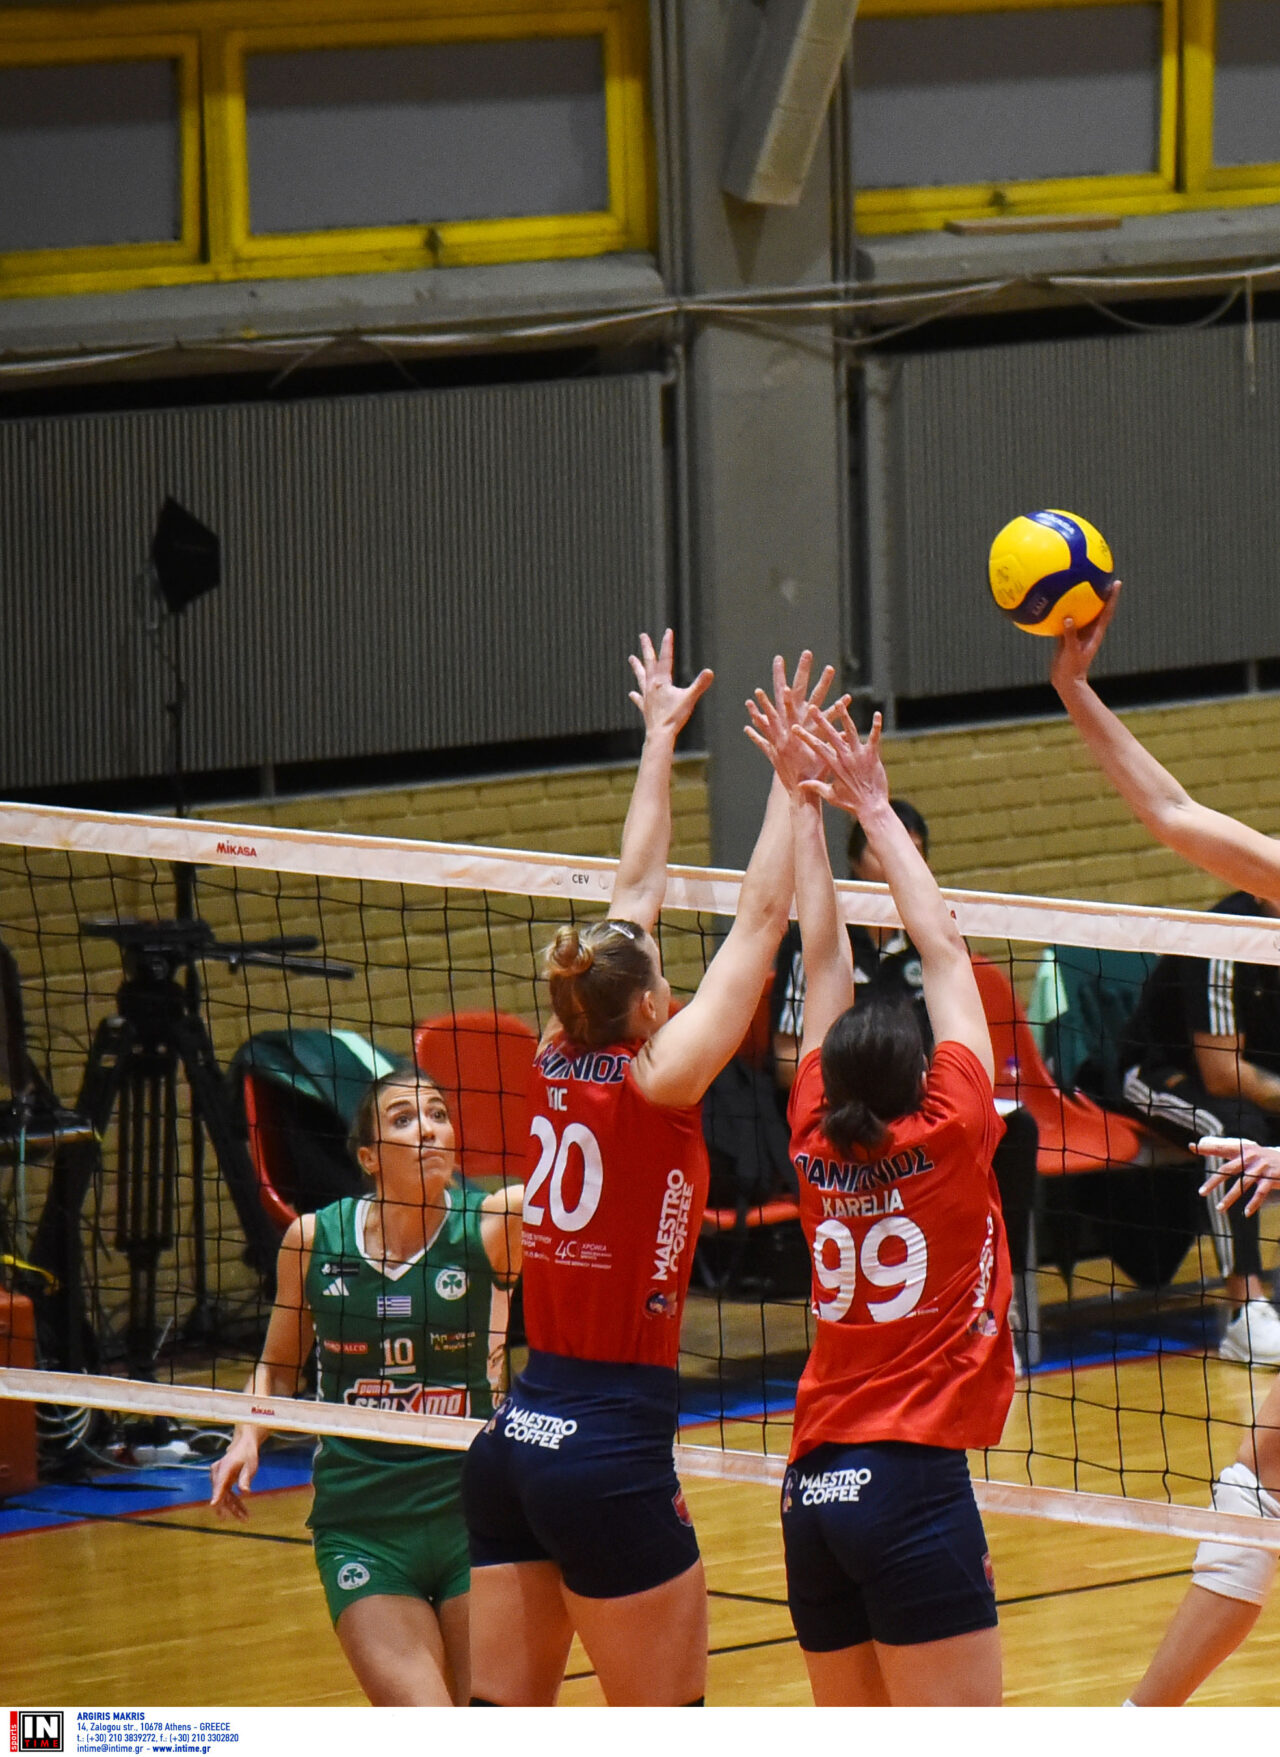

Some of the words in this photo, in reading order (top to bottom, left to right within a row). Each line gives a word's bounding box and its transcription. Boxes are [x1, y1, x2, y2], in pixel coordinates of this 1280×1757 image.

[571, 873, 590, 885] CEV
[522, 1115, 604, 1232] 20
[821, 1188, 904, 1218] KARELIA
[651, 1168, 685, 1281] MAESTRO
[669, 1182, 694, 1272] COFFEE
[812, 1216, 928, 1323] 99
[380, 1337, 415, 1366] 10
[504, 1422, 564, 1450] COFFEE
[505, 1407, 577, 1436] MAESTRO
[800, 1468, 871, 1491] MAESTRO
[802, 1484, 860, 1506] COFFEE
